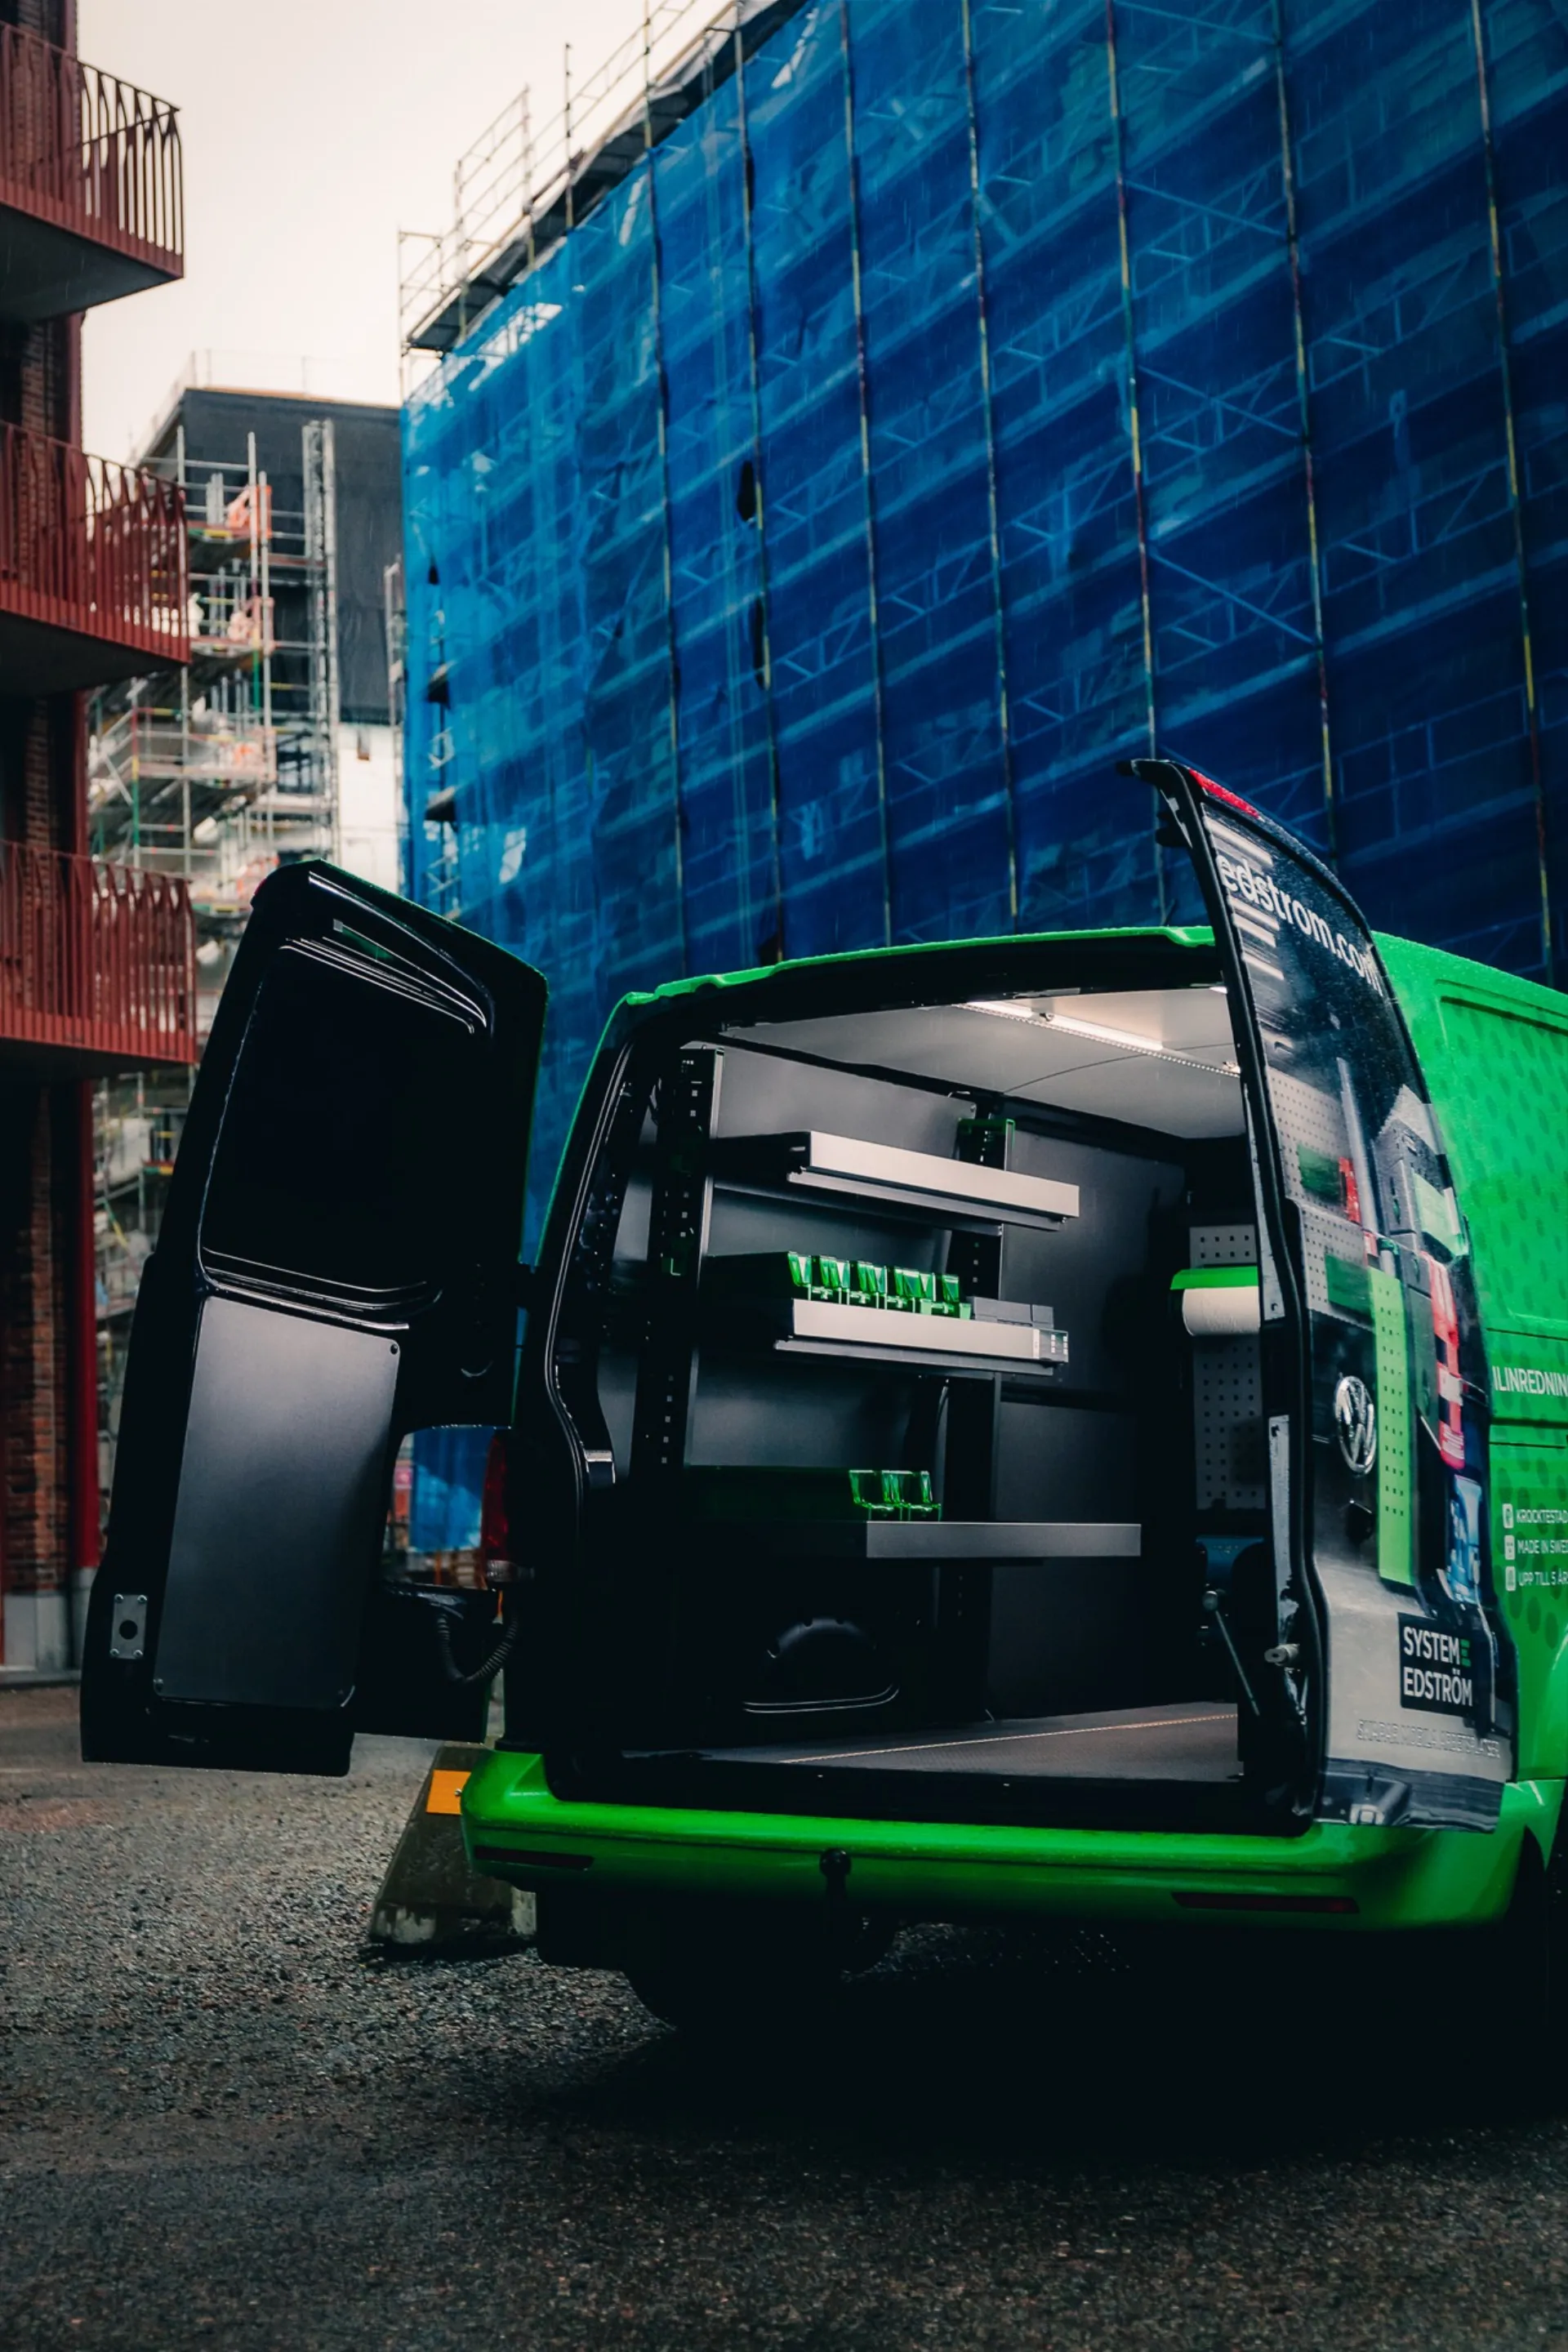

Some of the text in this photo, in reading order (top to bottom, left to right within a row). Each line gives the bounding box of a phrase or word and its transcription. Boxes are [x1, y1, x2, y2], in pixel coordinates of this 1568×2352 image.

[1216, 854, 1383, 997] edstrom.com
[1517, 1539, 1539, 1553] MADE
[1541, 1539, 1549, 1553] IN
[1518, 1571, 1534, 1586] UPP
[1535, 1571, 1550, 1586] TILL
[1403, 1666, 1472, 1707] EDSTRÖM
